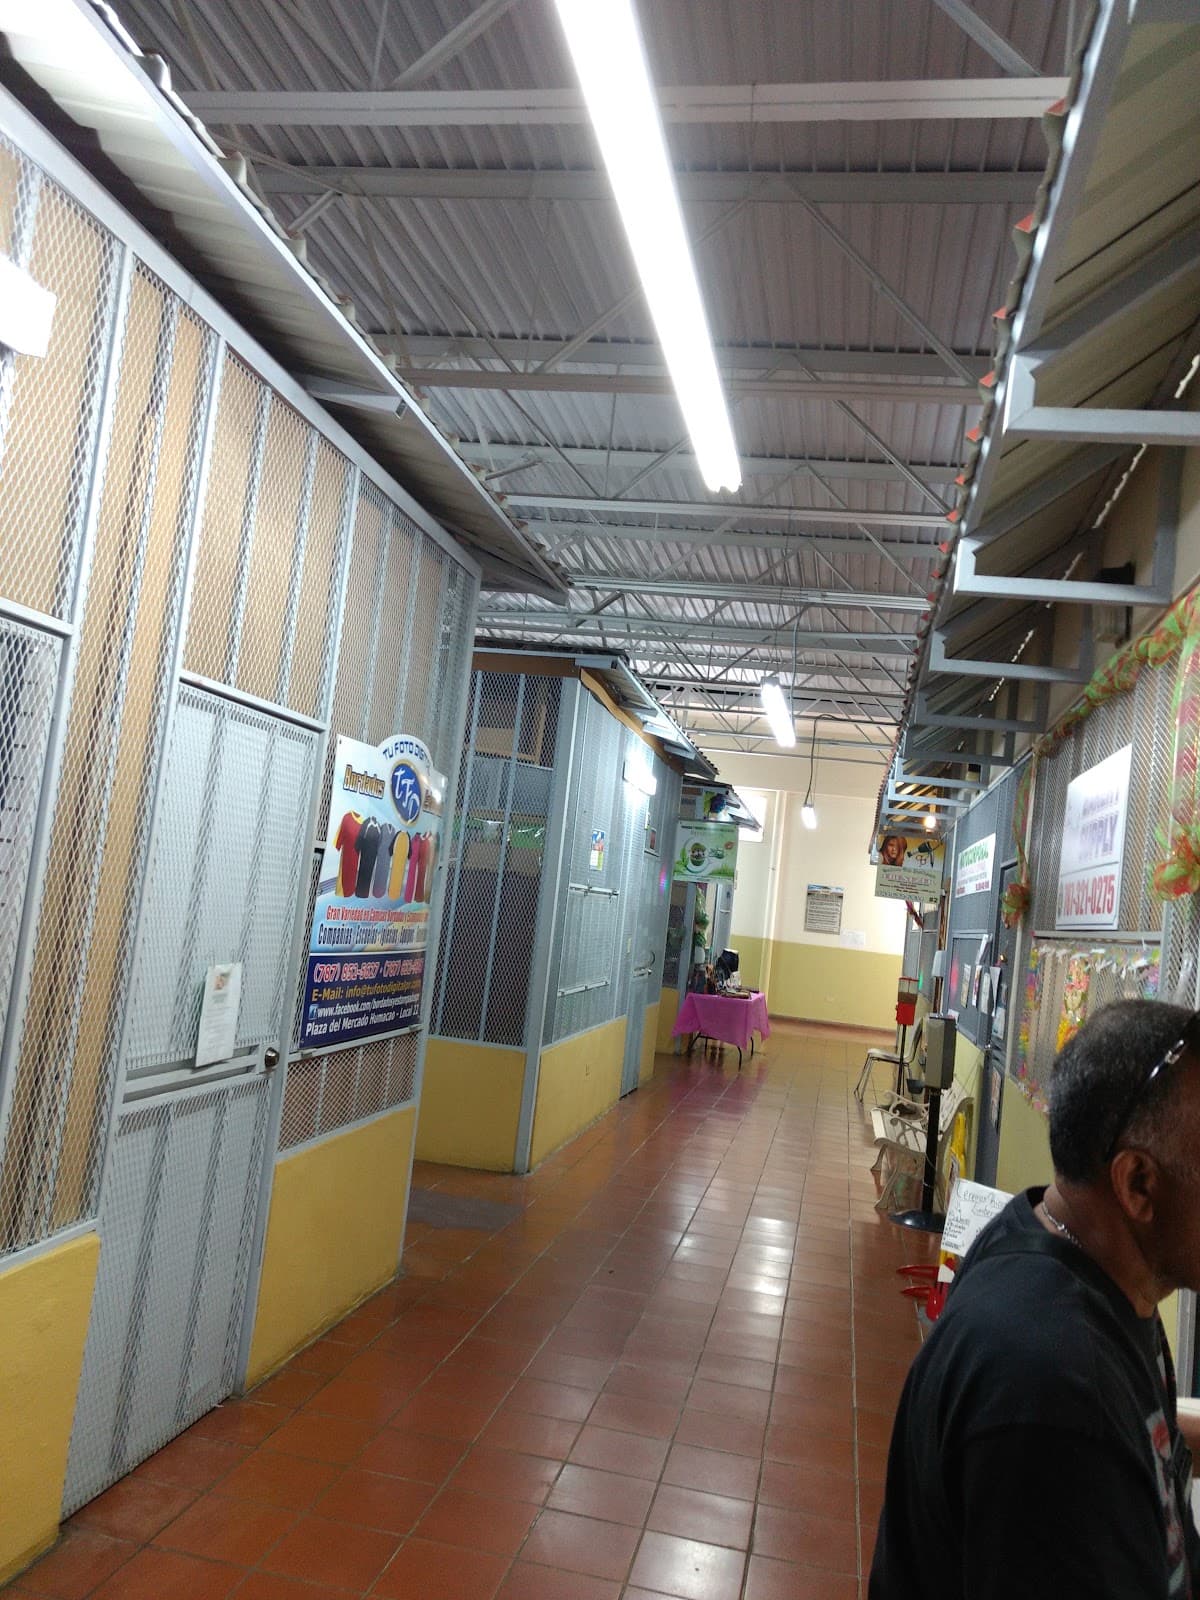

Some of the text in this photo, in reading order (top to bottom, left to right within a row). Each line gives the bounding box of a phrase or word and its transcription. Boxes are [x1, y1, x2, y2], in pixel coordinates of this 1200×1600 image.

[382, 746, 394, 760] TU
[394, 740, 414, 756] FOTO
[343, 764, 386, 800] Bordados
[327, 905, 341, 920] Gran
[314, 963, 341, 983] (787)
[312, 986, 344, 1002] E-Mail:
[305, 1021, 327, 1037] Plaza
[329, 1019, 342, 1032] del
[341, 1013, 369, 1031] Mercado
[369, 1010, 395, 1026] Humacao
[399, 1004, 413, 1019] Local
